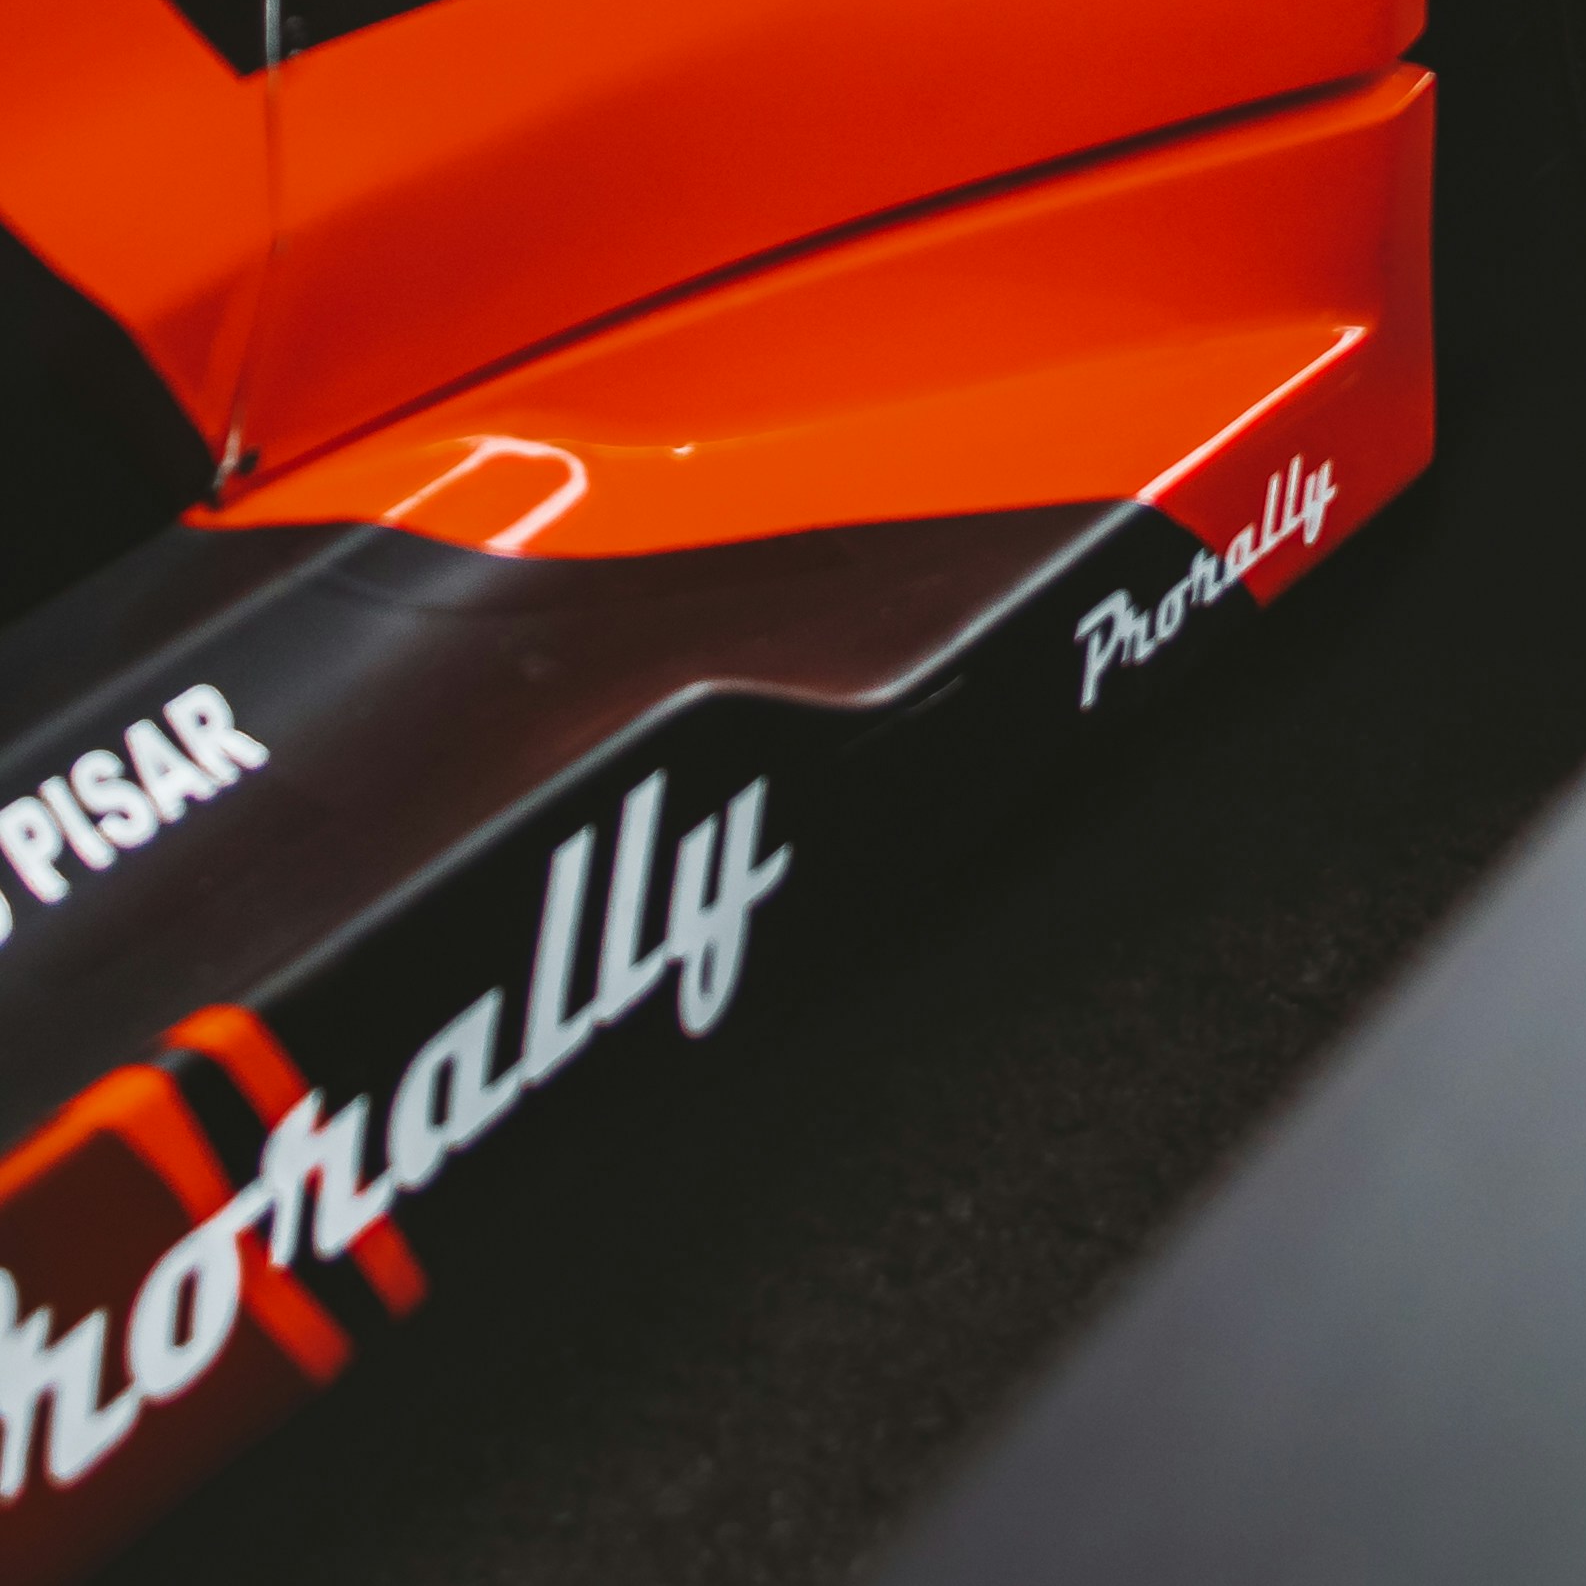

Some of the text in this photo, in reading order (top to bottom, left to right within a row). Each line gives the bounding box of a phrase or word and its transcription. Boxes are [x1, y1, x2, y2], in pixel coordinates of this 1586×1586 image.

[1074, 453, 1338, 713] Prorally
[1, 683, 271, 905] PISAR
[0, 767, 793, 1509] rorally
